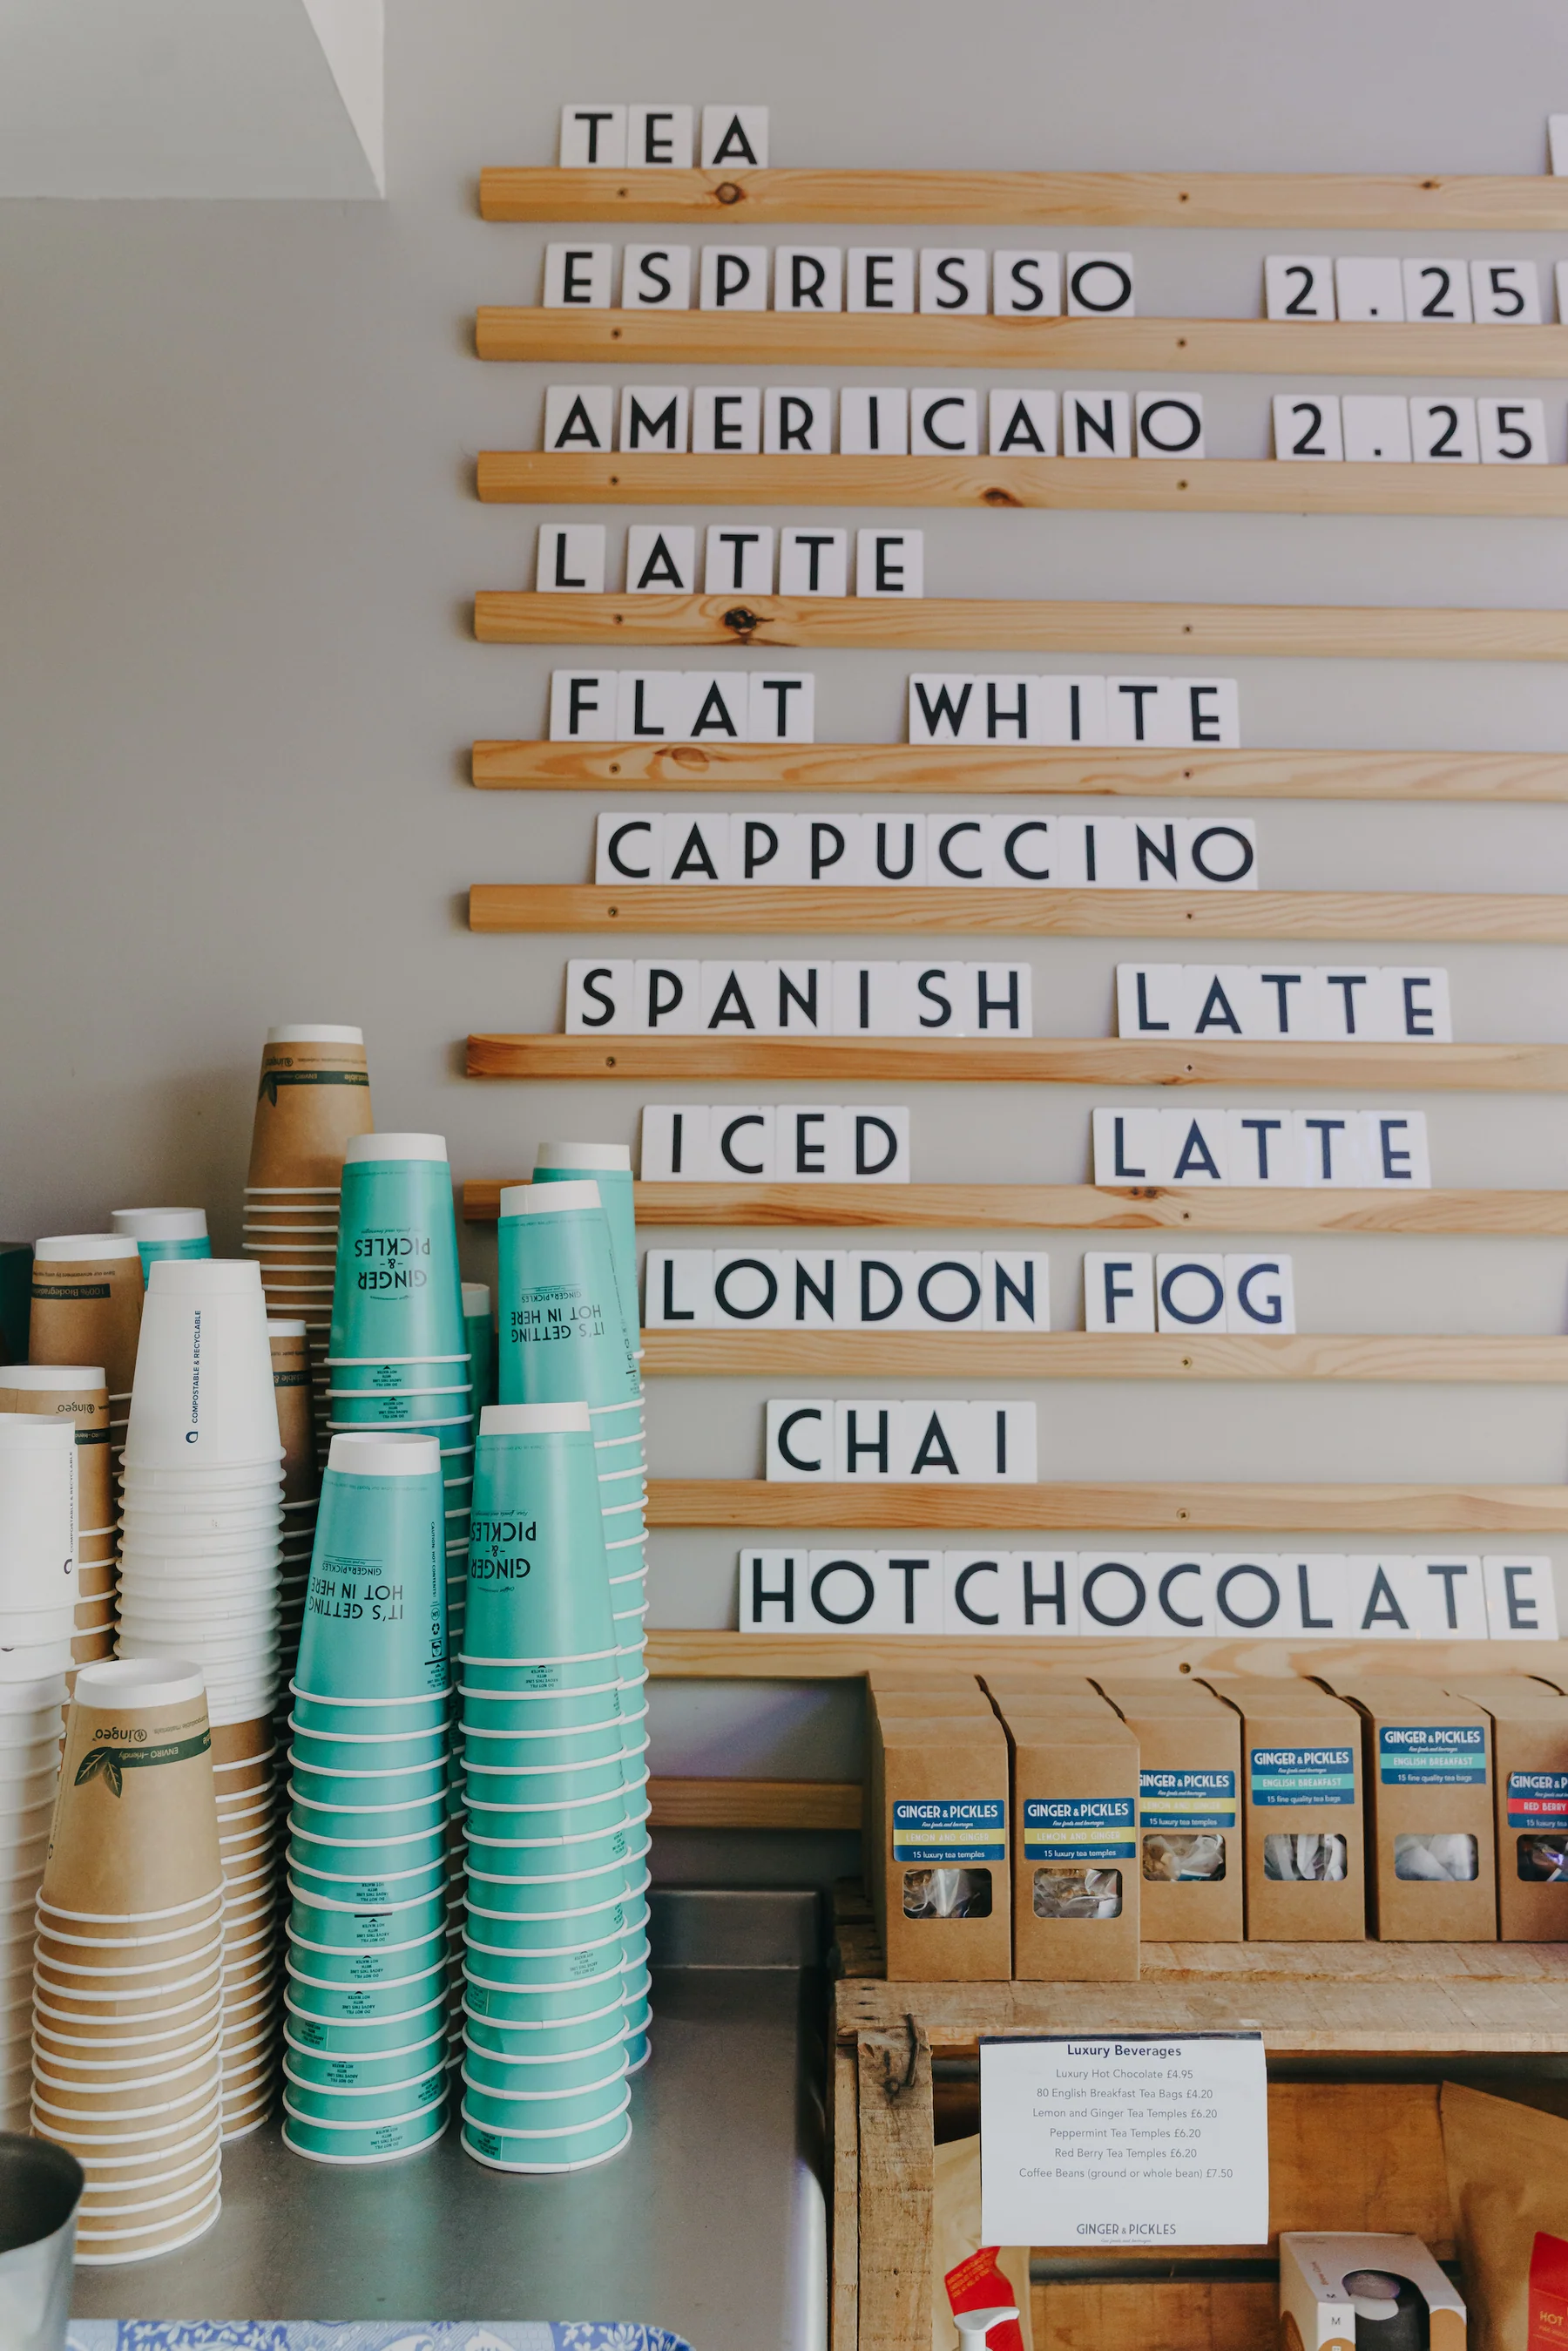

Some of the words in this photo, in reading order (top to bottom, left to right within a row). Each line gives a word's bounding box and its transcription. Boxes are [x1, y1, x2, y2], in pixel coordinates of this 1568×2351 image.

[574, 113, 758, 166] TEA
[563, 251, 1132, 312] ESPRESSO
[1284, 266, 1525, 318] 2.25
[554, 395, 1201, 454] AMERICANO
[1291, 403, 1532, 460] 2.25
[554, 532, 904, 592] LATTE
[569, 679, 802, 737] FLAT
[915, 682, 1220, 742] WHITE
[608, 821, 1254, 883] CAPPUCCINO
[582, 968, 1018, 1030] SPANISH
[1136, 972, 1435, 1036] LATTE
[671, 1114, 898, 1175] ICED
[1114, 1116, 1412, 1180] LATTE
[355, 1237, 430, 1257] PICKLES
[358, 1270, 428, 1291] GINGER
[521, 1293, 550, 1303] PICKLES
[554, 1291, 582, 1300] GINGER
[664, 1258, 1036, 1325] LONDON
[1103, 1263, 1282, 1325] FOG
[510, 1310, 541, 1325] HERE
[548, 1308, 562, 1323] IN
[570, 1304, 602, 1321] HOT
[511, 1325, 571, 1343] GETTING
[578, 1322, 605, 1338] IT'S
[778, 1408, 1006, 1474] CHAI
[471, 1521, 537, 1542] PICKLES
[321, 1562, 347, 1574] PICKLES
[352, 1567, 382, 1575] GINGER
[471, 1558, 531, 1579] GINGER
[311, 1576, 335, 1597] HERE
[341, 1582, 355, 1599] IN
[364, 1585, 402, 1601] HOT
[308, 1596, 362, 1619] GETTING
[372, 1604, 403, 1622] IT'S
[1384, 1731, 1427, 1744] GINGER
[1428, 1735, 1434, 1744] &
[1435, 1731, 1480, 1744] PICKLES
[151, 1746, 179, 1758] ENVIRO
[1254, 1752, 1295, 1765] GINGER
[1297, 1756, 1303, 1765] &
[1303, 1751, 1349, 1765] PICKLES
[1394, 1757, 1426, 1765] ENGLISH
[1429, 1757, 1473, 1765] BREAKFAST
[1177, 1778, 1182, 1787] &
[1184, 1775, 1230, 1787] PICKLES
[1262, 1778, 1295, 1787] ENGLISH
[1298, 1778, 1342, 1786] BREAKFAST
[1422, 1774, 1443, 1783] quality
[1456, 1774, 1472, 1783] bags
[1511, 1775, 1552, 1788] GINGER
[897, 1806, 941, 1818] GINGER
[950, 1805, 998, 1818] PICKLES
[1028, 1804, 1071, 1817] GINGER
[1073, 1808, 1079, 1817] &
[1081, 1803, 1129, 1817] PICKLES
[1524, 1802, 1539, 1811] RED
[1542, 1802, 1566, 1811] BERRY
[1159, 1818, 1179, 1826] luxury
[1192, 1818, 1217, 1826] temples
[906, 1833, 936, 1842] LEMON
[939, 1833, 956, 1842] AND
[959, 1833, 989, 1841] GINGER
[1070, 1832, 1087, 1840] AND
[1091, 1832, 1120, 1840] GINGER
[923, 1851, 943, 1860] luxury
[957, 1851, 985, 1860] temples
[1054, 1850, 1075, 1859] luxury
[1089, 1849, 1116, 1858] temples
[1067, 2044, 1111, 2058] Luxury
[1115, 2044, 1182, 2058] Beverages
[1056, 2070, 1088, 2081] Luxury
[1092, 2070, 1110, 2079] Hot
[1113, 2070, 1163, 2079] Chocolate
[1166, 2070, 1193, 2079] £4.95
[1037, 2088, 1049, 2097] 80
[1051, 2088, 1087, 2100] English
[1090, 2088, 1136, 2098] Breakfast
[1139, 2090, 1156, 2098] Tea
[1159, 2090, 1183, 2101] Bags
[1186, 2090, 1213, 2099] £4.20
[1033, 2108, 1066, 2117] Lemon
[1069, 2108, 1087, 2118] and
[1090, 2109, 1124, 2120] Ginger
[1127, 2109, 1144, 2118] Tea
[1146, 2109, 1187, 2121] Temples
[1191, 2109, 1218, 2119] £6.20
[1050, 2128, 1107, 2140] Peppermint
[1111, 2129, 1127, 2138] Tea
[1131, 2128, 1171, 2140] Temples
[1174, 2129, 1201, 2138] £6.20
[1055, 2148, 1074, 2158] Red
[1077, 2148, 1104, 2160] Berry
[1106, 2149, 1123, 2158] Tea
[1126, 2148, 1166, 2160] Temples
[1170, 2149, 1197, 2158] £6.20
[1019, 2168, 1052, 2178] Coffee
[1056, 2168, 1085, 2178] Beans
[1087, 2168, 1127, 2180] (ground
[1143, 2168, 1173, 2178] whole
[1175, 2168, 1203, 2180] bean)
[1206, 2168, 1233, 2178] £7.50
[1077, 2223, 1119, 2235] GINGER
[1129, 2223, 1176, 2235] PICKLES
[1539, 2310, 1564, 2327] HOT
